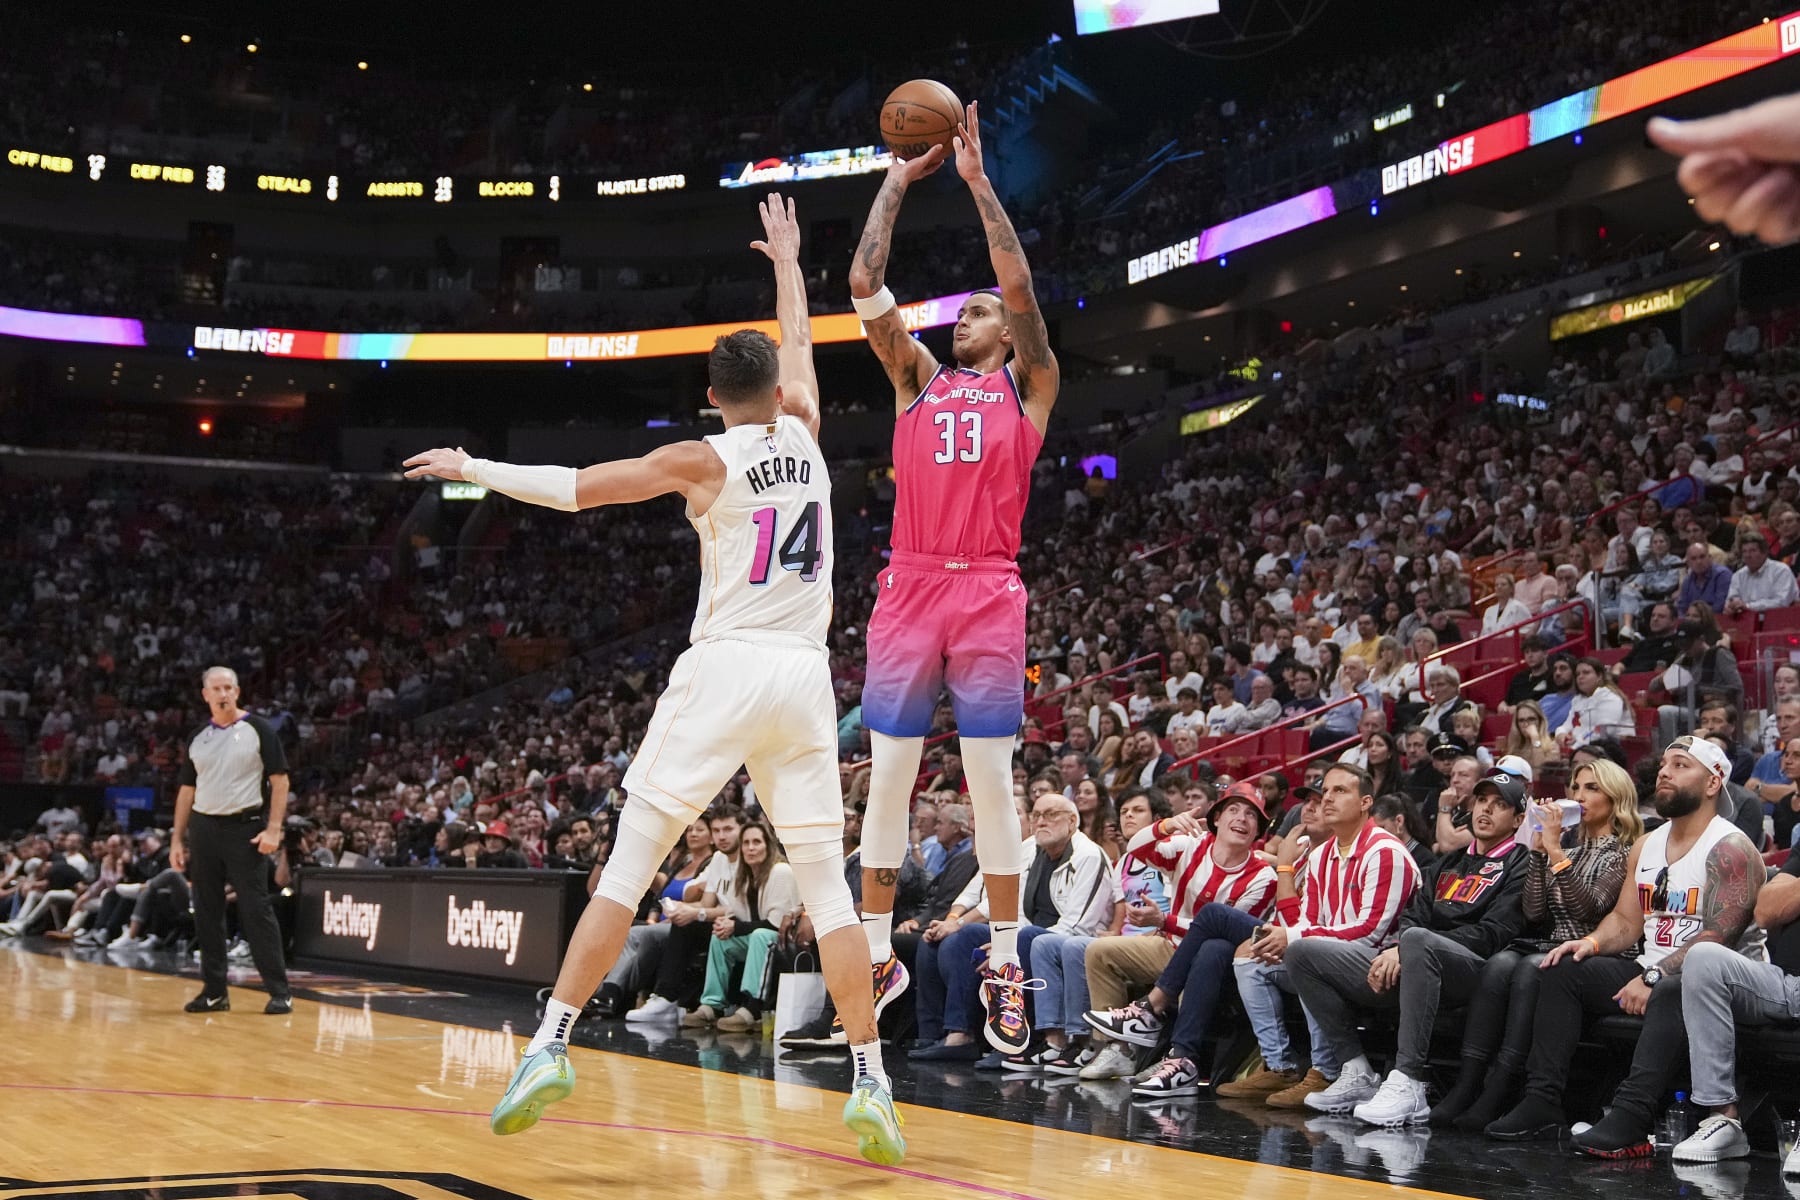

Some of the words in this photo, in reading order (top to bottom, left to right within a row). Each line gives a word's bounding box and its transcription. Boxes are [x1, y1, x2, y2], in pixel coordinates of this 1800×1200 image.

[8, 149, 40, 168] OFF
[40, 154, 74, 173] REB
[130, 163, 162, 180] DEF
[162, 166, 194, 184] REB
[1381, 136, 1475, 195] DEFENSE
[257, 174, 312, 194] STEALS
[366, 181, 424, 197] ASSISTS
[478, 181, 534, 197] BLOCKS
[597, 178, 648, 195] HUSTLE
[647, 173, 686, 191] STATS
[1127, 236, 1199, 285] DEFENSE
[194, 326, 294, 354] DEFENSE
[547, 334, 639, 358] DEFENSE
[934, 411, 982, 464] 33
[745, 456, 811, 495] HERRO
[749, 501, 824, 587] 14
[322, 890, 381, 951] betway
[447, 895, 524, 966] betway
[1654, 915, 1701, 948] 22
